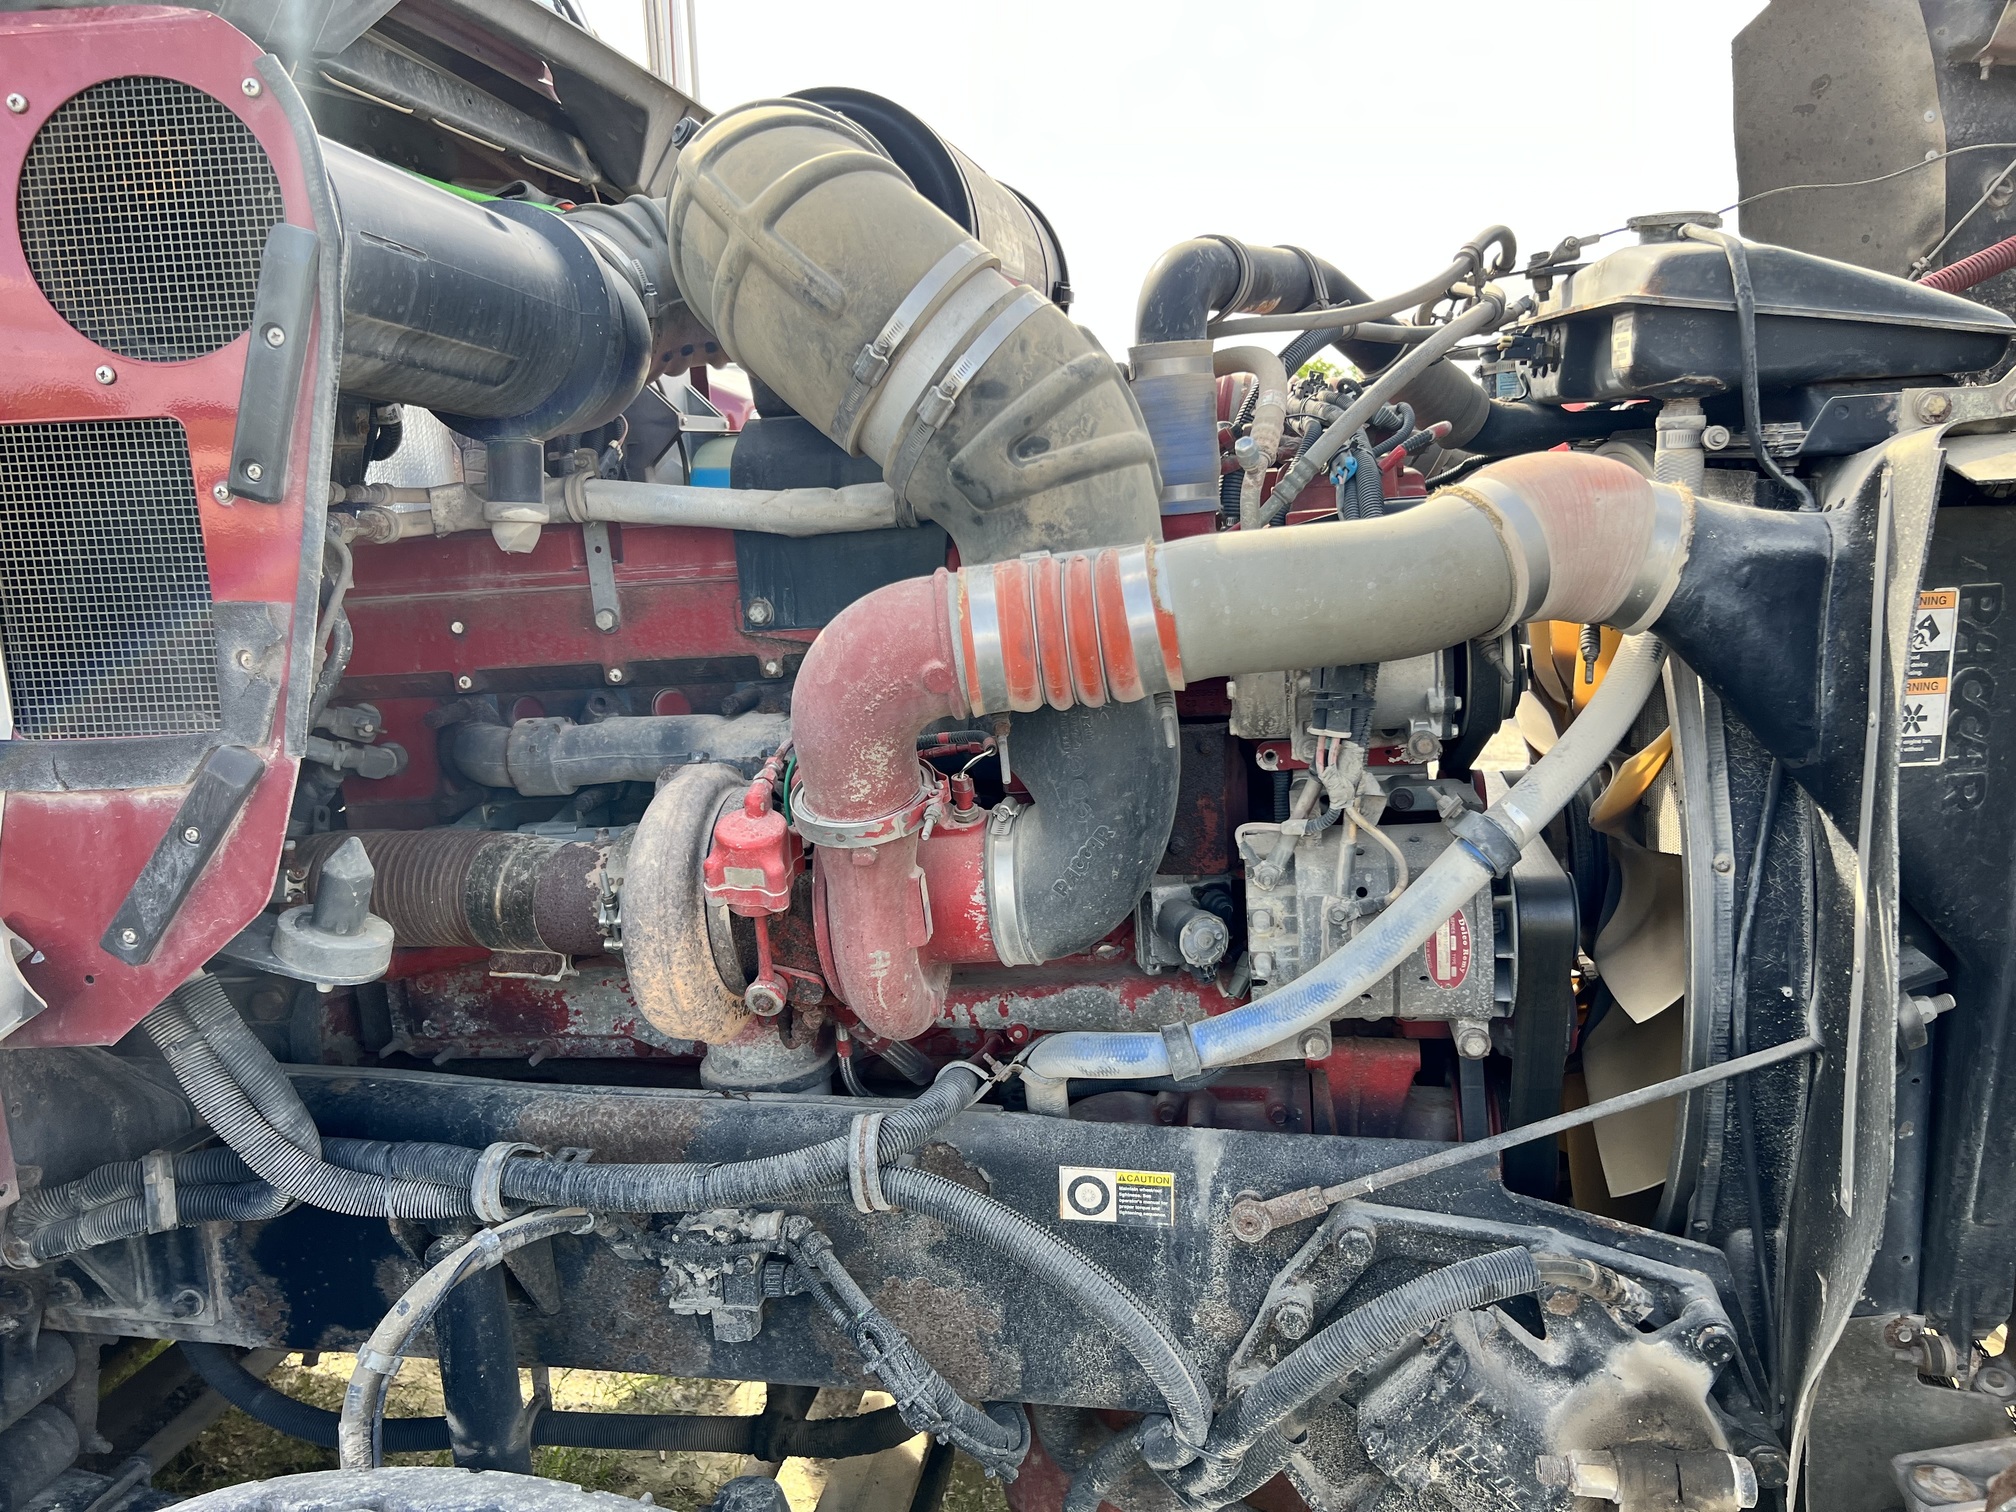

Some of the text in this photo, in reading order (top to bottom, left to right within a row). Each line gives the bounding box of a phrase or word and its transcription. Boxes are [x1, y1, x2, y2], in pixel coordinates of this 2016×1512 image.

[1919, 596, 1947, 606] NING
[1906, 681, 1939, 692] RNING
[1942, 582, 2005, 811] PACCAR
[1052, 824, 1116, 899] PACCAR
[1458, 918, 1469, 974] Delco Remy
[1127, 1175, 1170, 1184] CAUTION
